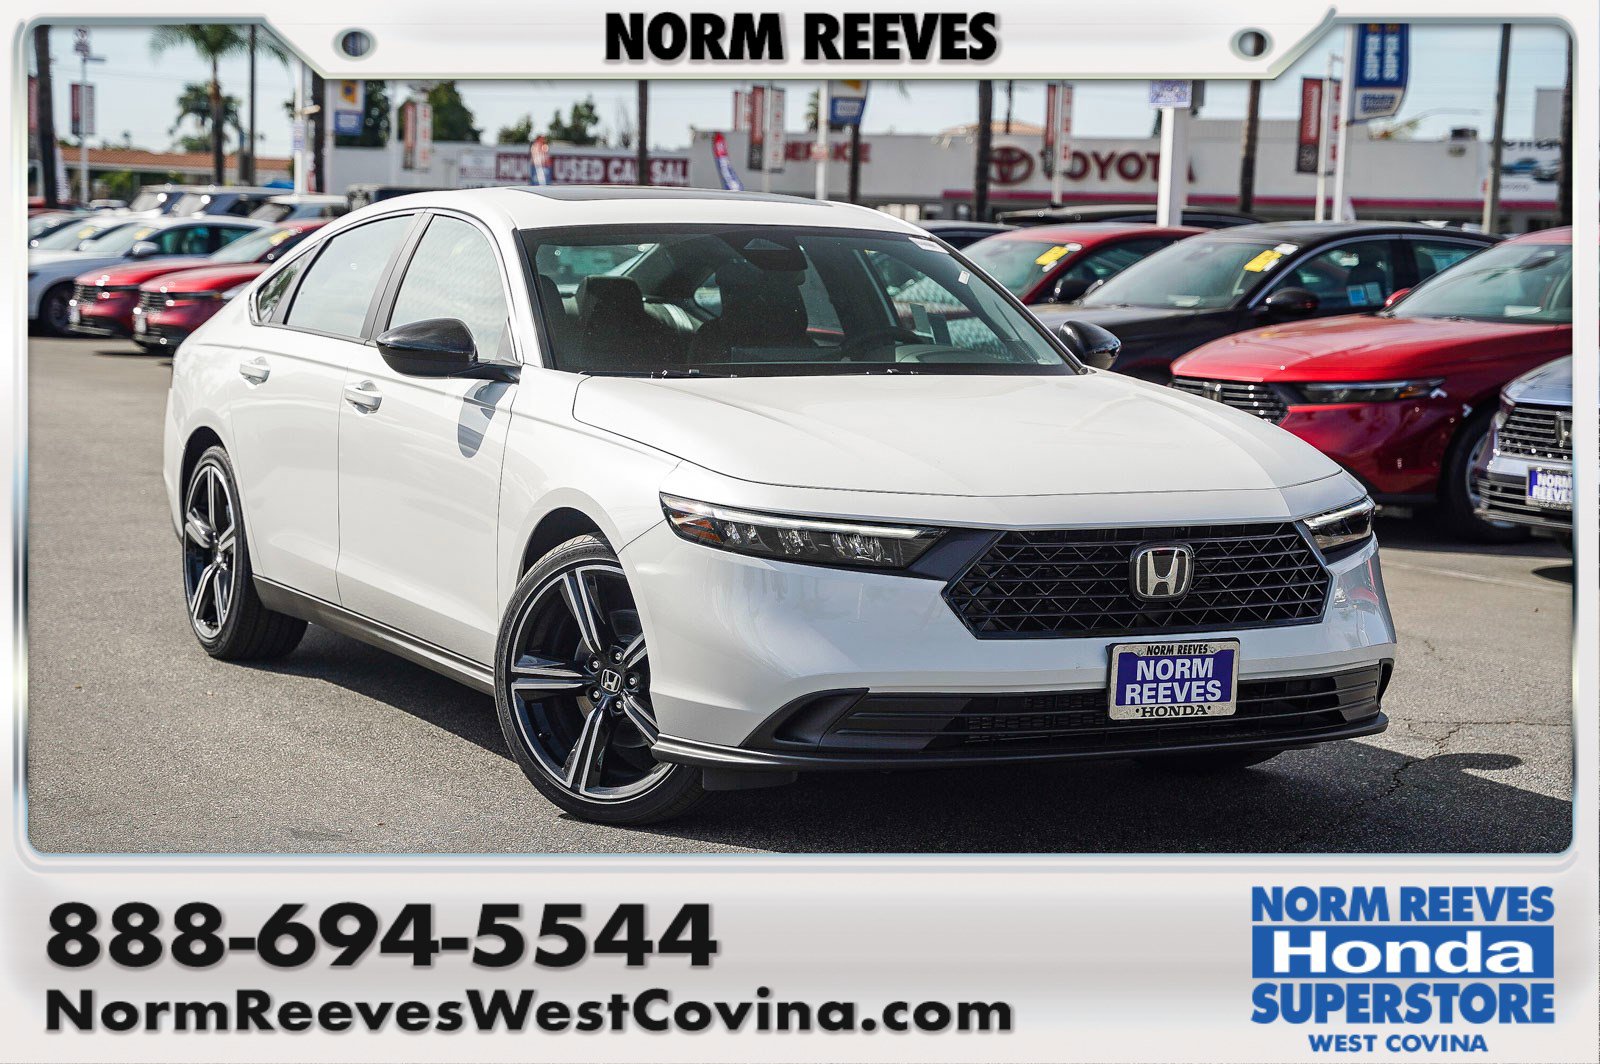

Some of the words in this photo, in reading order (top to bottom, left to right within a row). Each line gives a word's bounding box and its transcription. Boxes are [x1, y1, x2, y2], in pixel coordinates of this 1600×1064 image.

[554, 159, 604, 182] USED
[608, 160, 639, 183] CA
[650, 160, 688, 184] SAL
[1040, 151, 1196, 183] OYOT
[1146, 645, 1174, 656] NORM
[1177, 643, 1208, 655] REEVES
[1136, 657, 1214, 681] NORM
[1125, 679, 1222, 705] REEVES
[1140, 704, 1208, 718] HONDA
